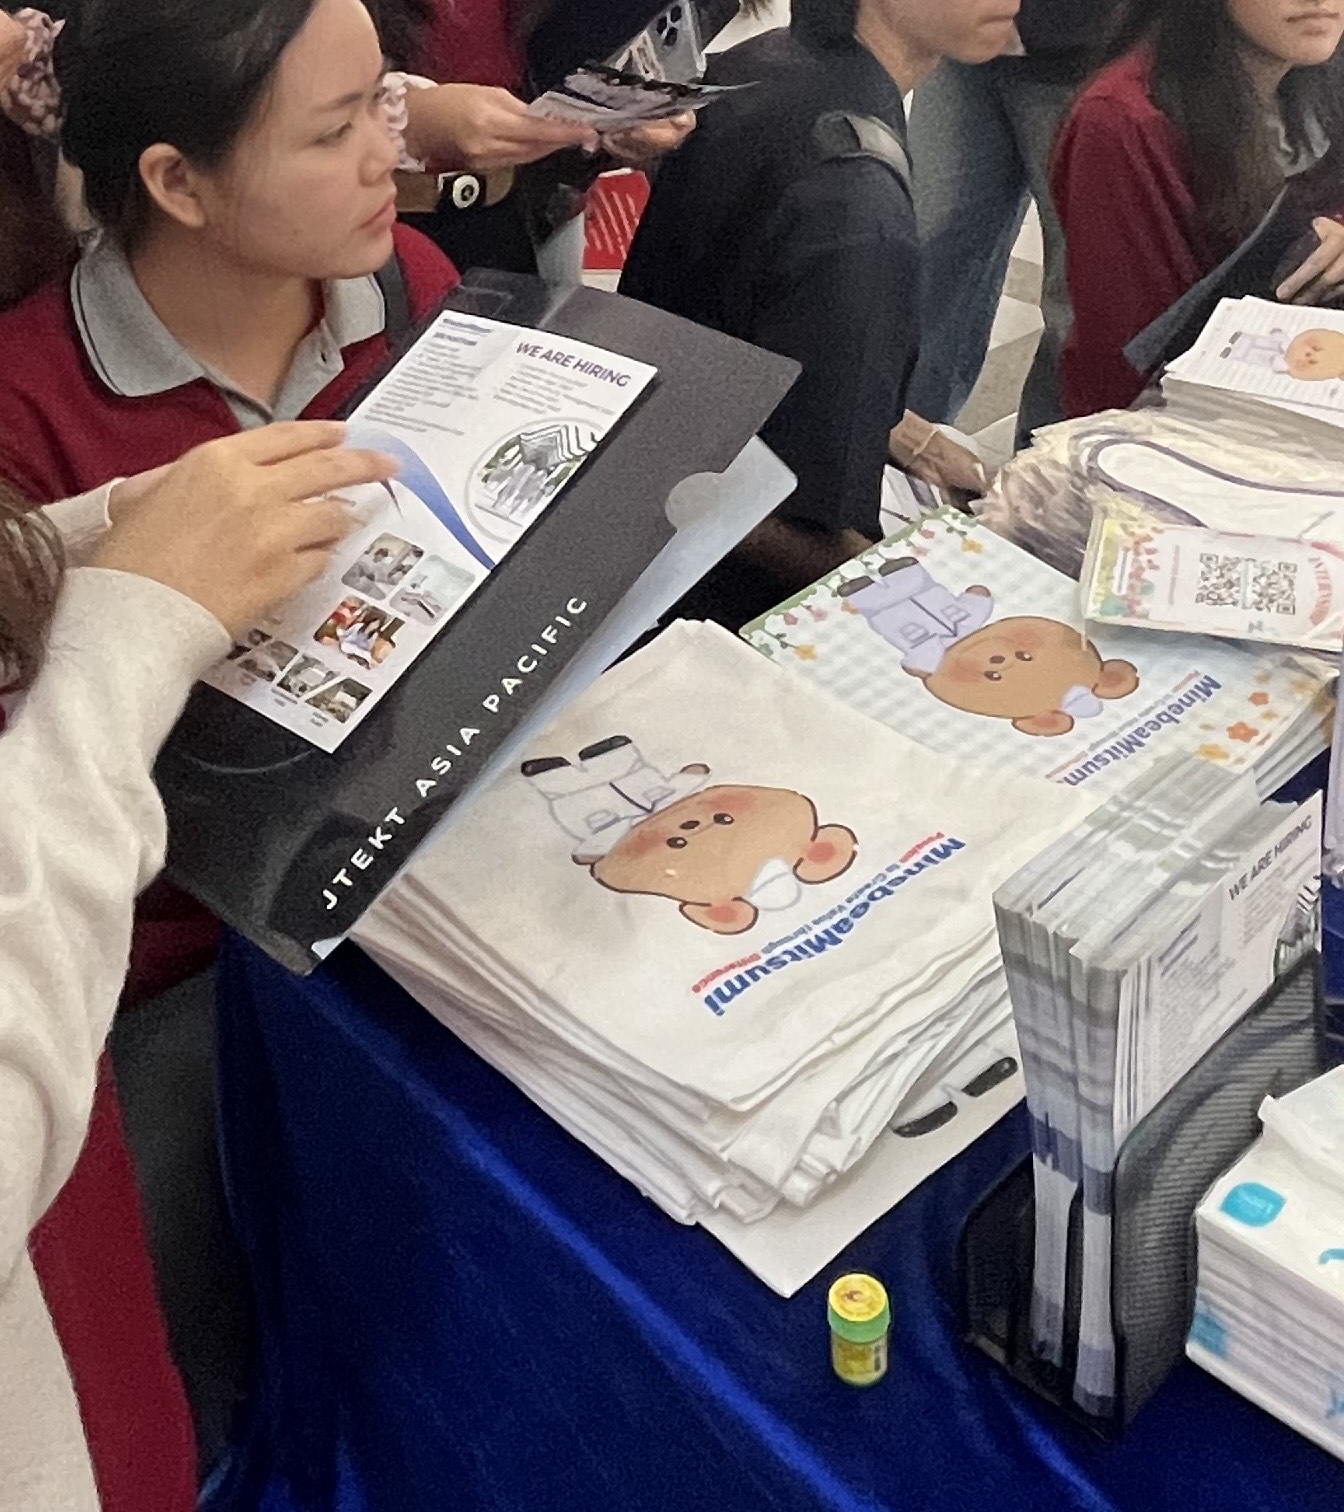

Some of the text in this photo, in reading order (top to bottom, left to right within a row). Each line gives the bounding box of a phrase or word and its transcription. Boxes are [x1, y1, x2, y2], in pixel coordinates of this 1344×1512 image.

[516, 342, 631, 387] WE ARE HIRING
[322, 596, 587, 909] JTEKT ASIA PACIFIC
[1056, 674, 1222, 786] MinebeaMitsum
[704, 838, 966, 1016] MinebeaMitsumi
